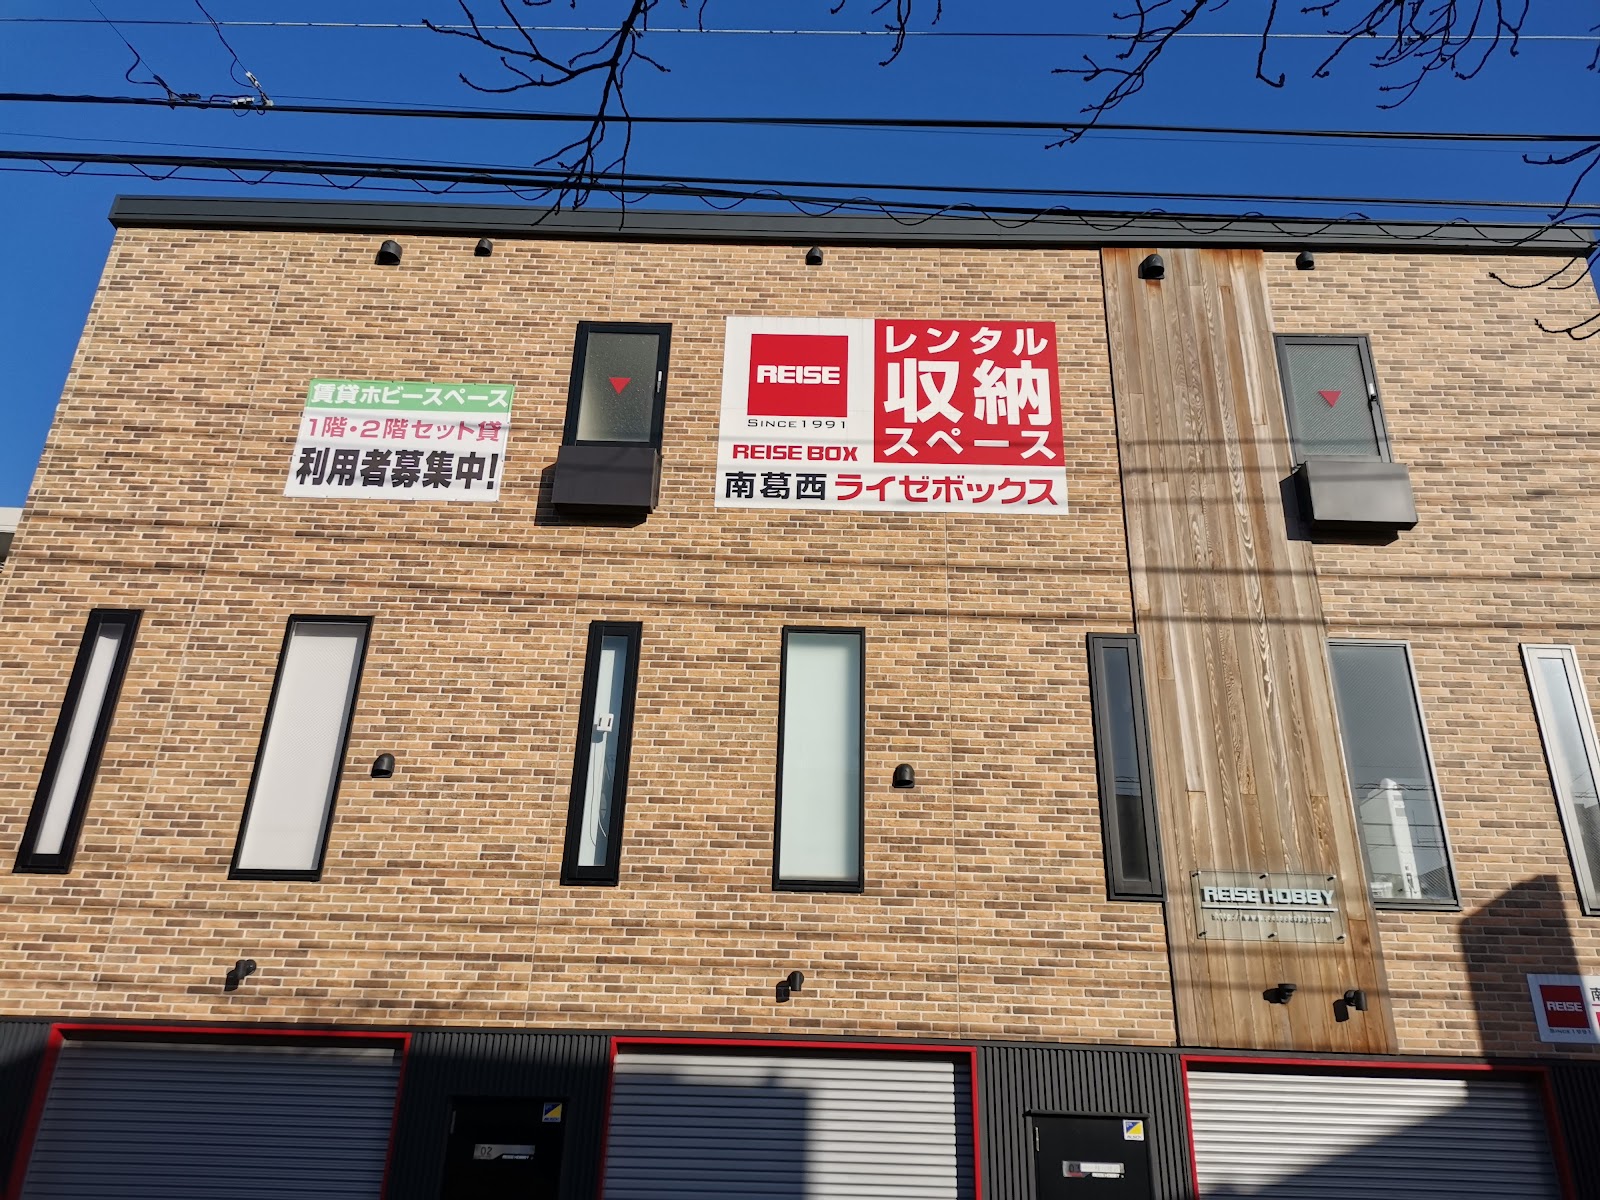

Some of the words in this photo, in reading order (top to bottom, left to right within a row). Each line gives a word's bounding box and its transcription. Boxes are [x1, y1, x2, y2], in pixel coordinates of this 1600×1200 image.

[886, 326, 1048, 356] レンタル
[756, 365, 840, 385] REISE
[311, 383, 508, 407] 賃貸ホビースペース
[883, 358, 1052, 426] 収納
[747, 418, 797, 428] SINCE
[802, 419, 846, 429] 1991
[732, 444, 802, 460] REISE
[807, 446, 858, 462] BOX
[883, 428, 1056, 460] スペース
[295, 446, 499, 490] 利用者募集中!
[725, 470, 827, 501] 南葛西
[834, 473, 1058, 506] ライゼボックス
[1203, 886, 1259, 902] REISE
[1262, 888, 1334, 905] HOBBY
[1546, 1001, 1583, 1012] REISE
[480, 1146, 493, 1156] 02
